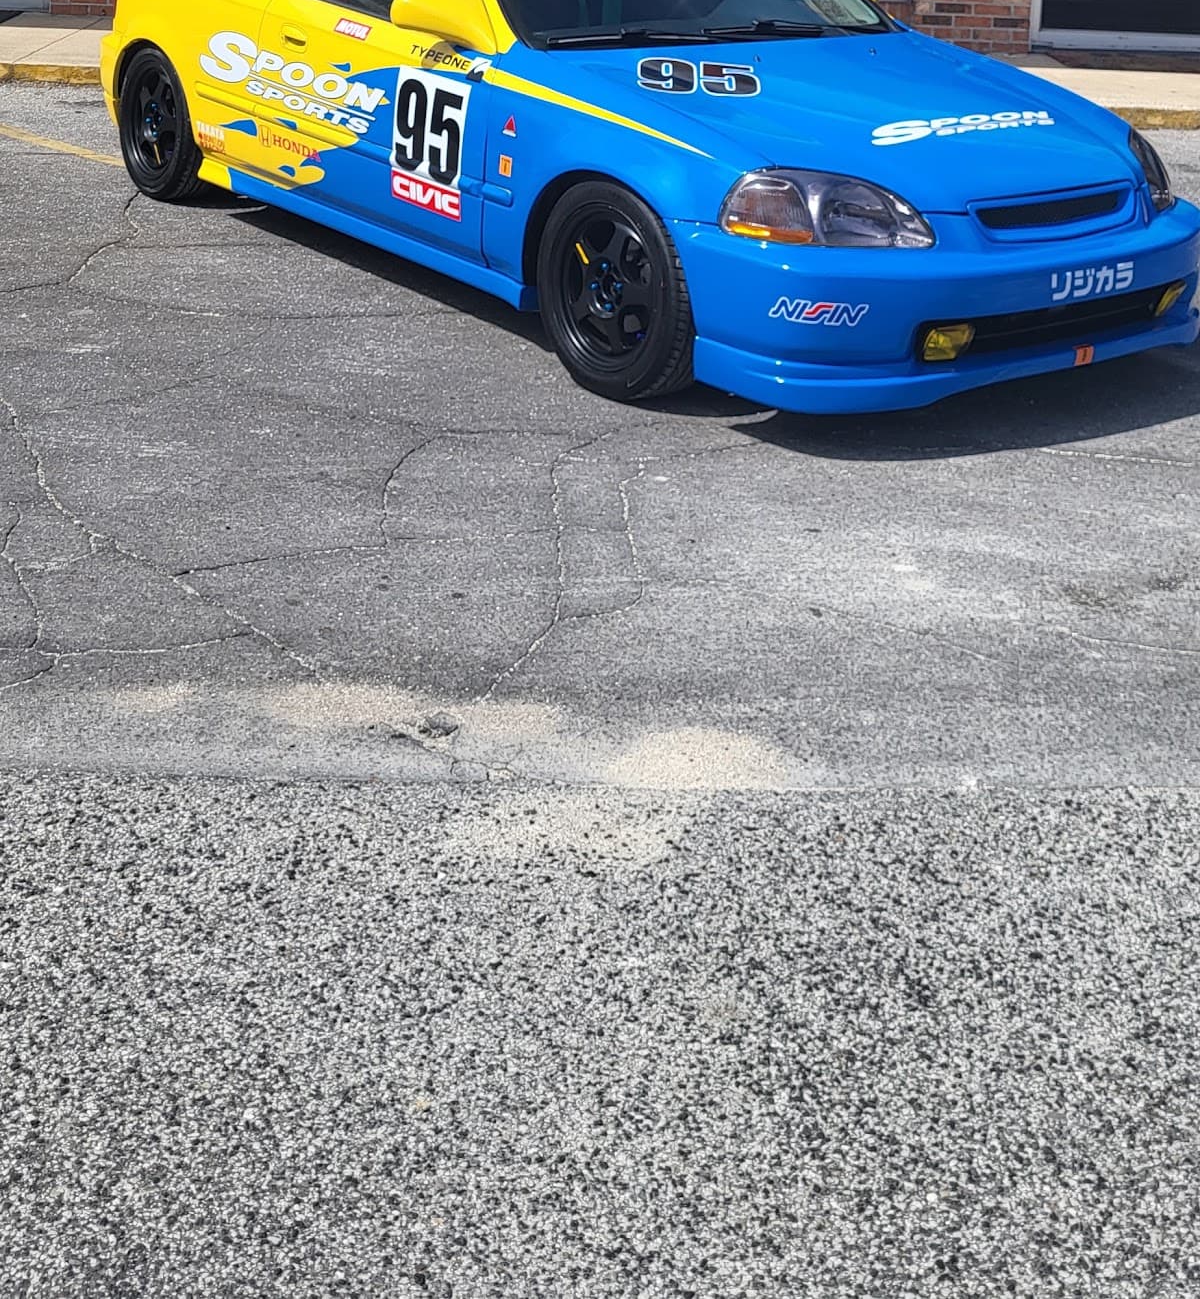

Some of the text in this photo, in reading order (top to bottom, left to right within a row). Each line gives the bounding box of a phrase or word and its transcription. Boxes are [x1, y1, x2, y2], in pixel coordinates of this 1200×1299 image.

[337, 19, 370, 40] MOTUL
[199, 31, 387, 113] SPOON
[636, 56, 761, 97] 95
[245, 80, 371, 134] SPORTS
[936, 118, 1055, 136] SPORTS
[272, 134, 322, 162] HONDA
[395, 78, 464, 185] 95
[871, 111, 1049, 146] SPOON
[392, 175, 461, 217] CIVIC
[1051, 261, 1134, 301] リジカラ
